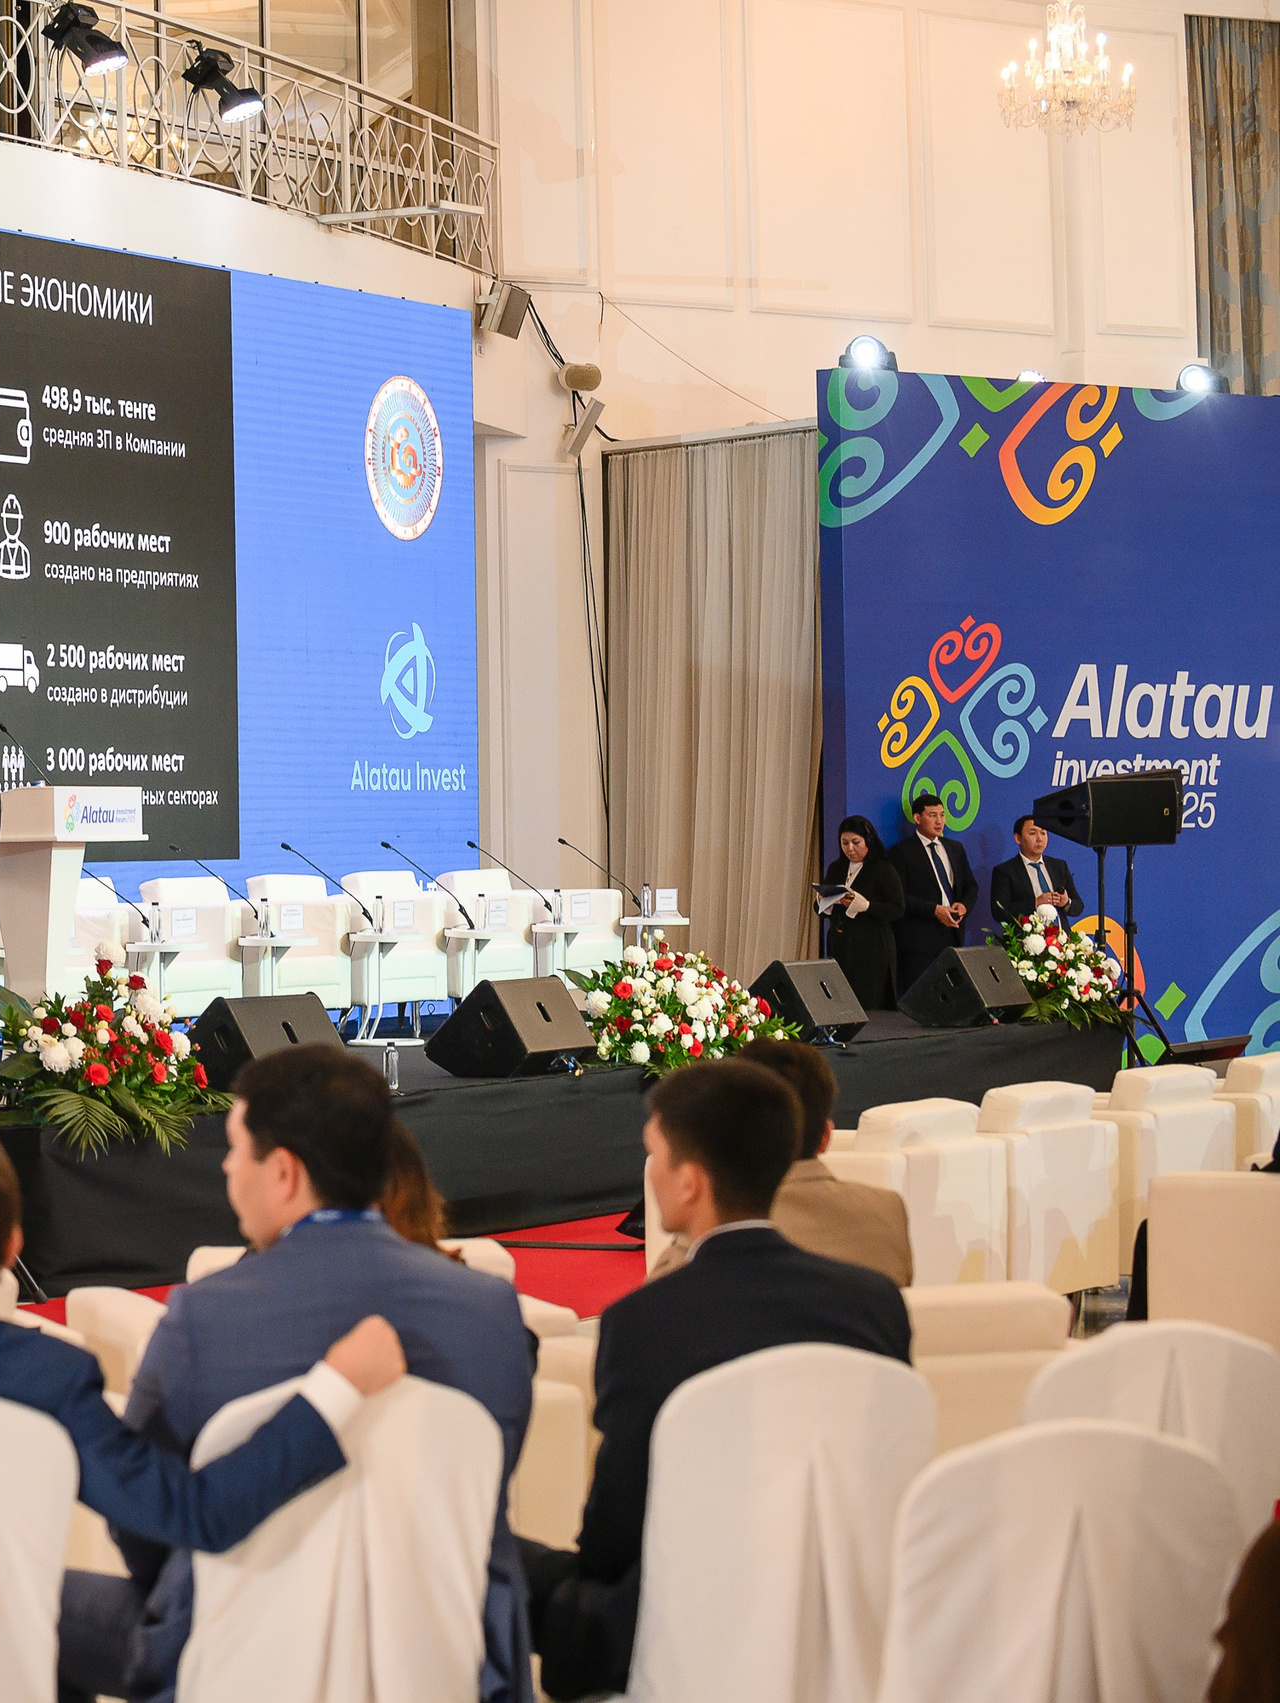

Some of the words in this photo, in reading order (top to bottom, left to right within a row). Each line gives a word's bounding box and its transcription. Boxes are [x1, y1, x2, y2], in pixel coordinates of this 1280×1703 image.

[20, 273, 152, 325] ЭКОНОМИКИ
[42, 385, 82, 415] 498,9
[85, 395, 115, 416] тыс.
[118, 400, 156, 421] тенге
[43, 427, 93, 449] средняя
[97, 429, 112, 449] ЗП
[116, 436, 122, 450] в
[126, 432, 185, 457] Компании
[44, 520, 70, 545] 900
[74, 523, 134, 551] рабочих
[138, 534, 171, 553] мест
[45, 563, 95, 584] создано
[98, 567, 113, 582] на
[116, 568, 199, 590] предприятиях
[47, 643, 55, 667] 2
[59, 644, 85, 668] 500
[89, 645, 149, 674] рабочих
[152, 654, 185, 672] мест
[47, 686, 97, 706] создано
[101, 688, 108, 703] в
[110, 684, 187, 709] дистрибуции
[1051, 664, 1274, 739] Alatau
[46, 747, 55, 771] 3
[58, 747, 85, 772] 000
[89, 747, 148, 776] рабочих
[152, 754, 184, 772] мест
[350, 760, 411, 791] Alatau
[416, 760, 466, 791] Invest
[142, 790, 165, 805] ных
[168, 790, 218, 809] секторах
[81, 806, 115, 824] Alatau
